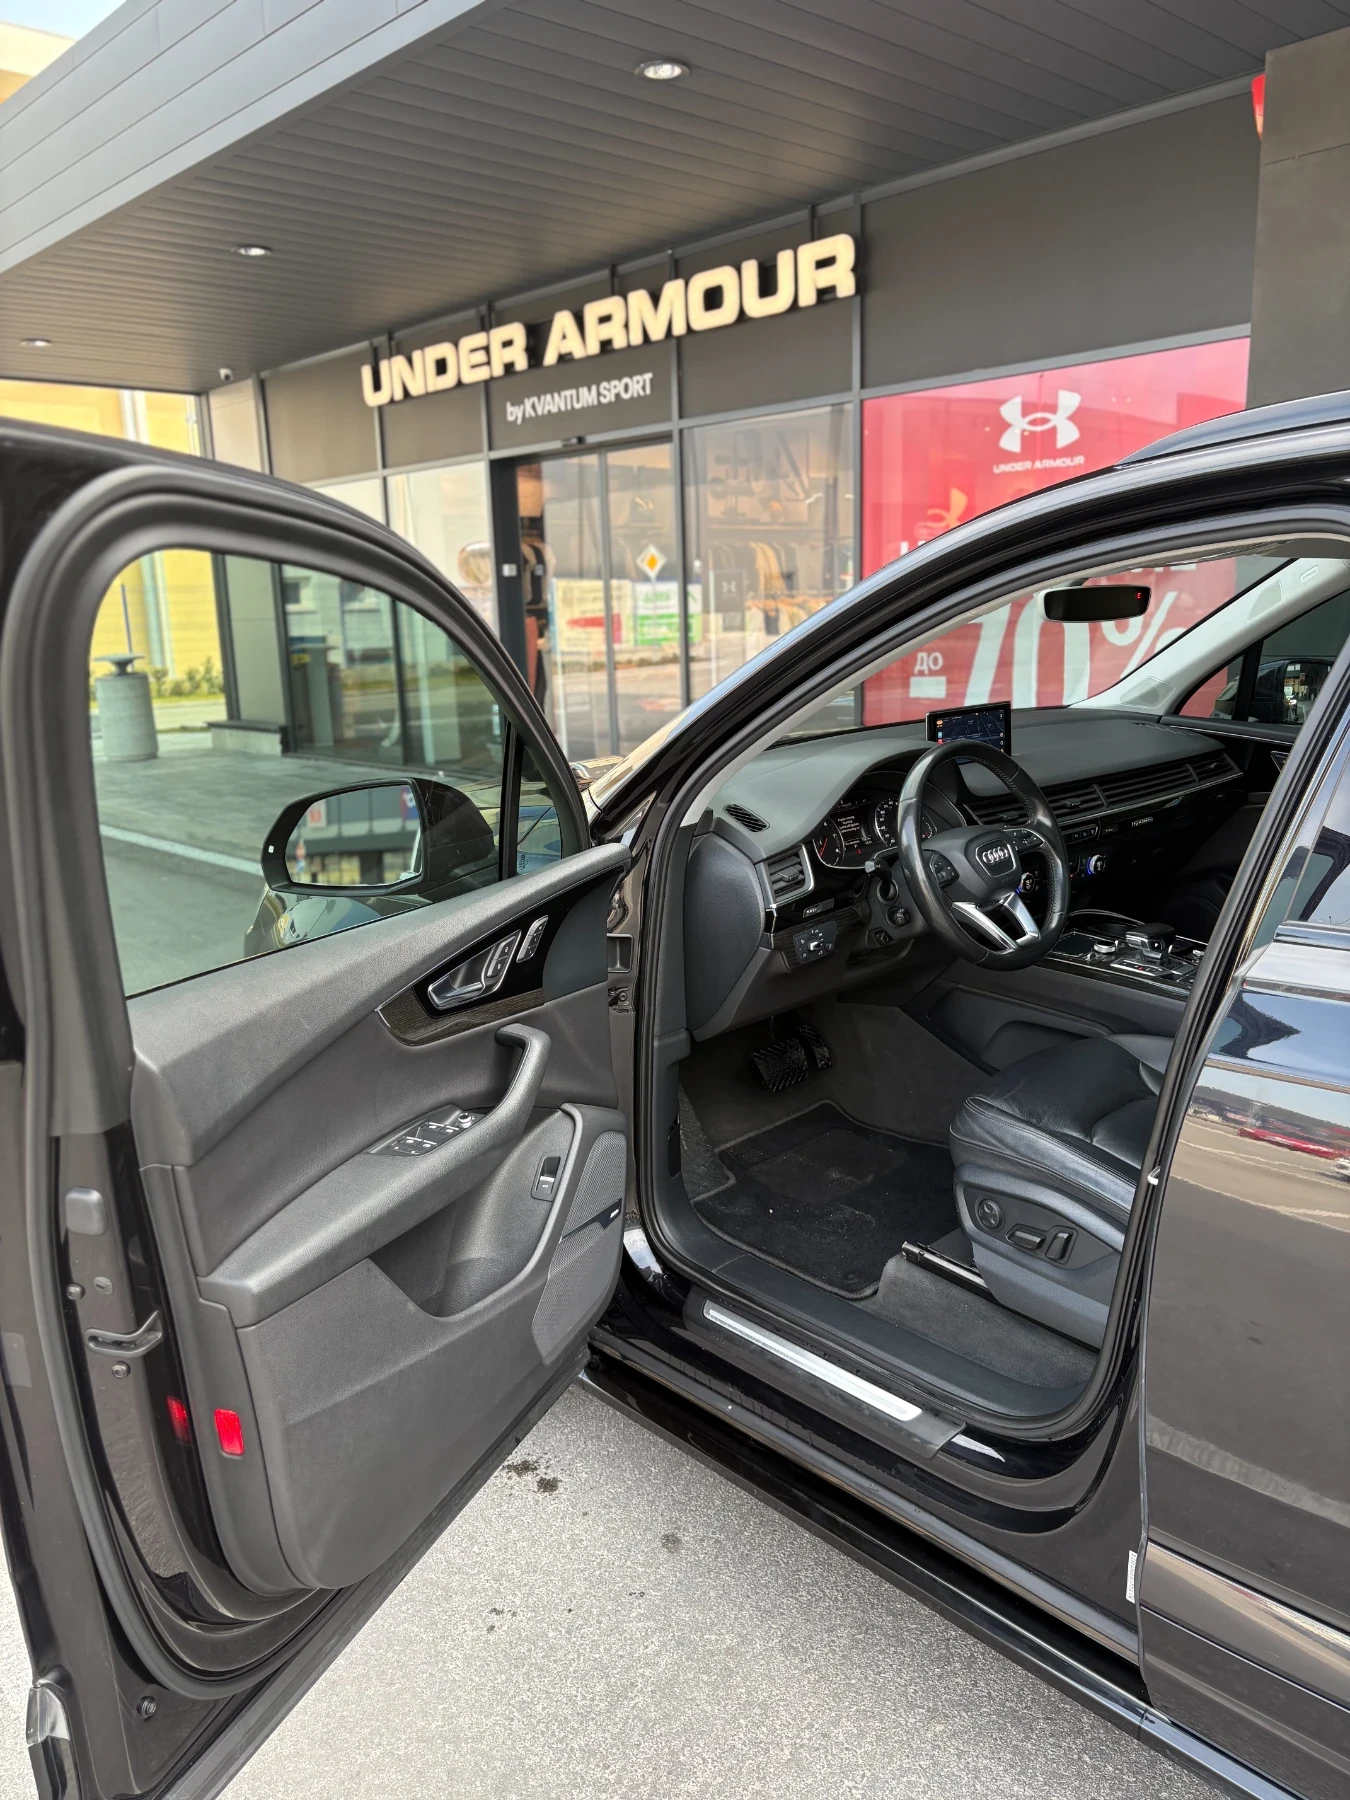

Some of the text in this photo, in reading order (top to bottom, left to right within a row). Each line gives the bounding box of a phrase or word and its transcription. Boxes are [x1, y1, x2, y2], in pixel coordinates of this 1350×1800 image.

[361, 233, 856, 407] UNDER ARMOUR
[524, 384, 598, 418] KVANTUM
[599, 372, 653, 404] SPORT
[993, 455, 1085, 474] UNDER ARMOUR
